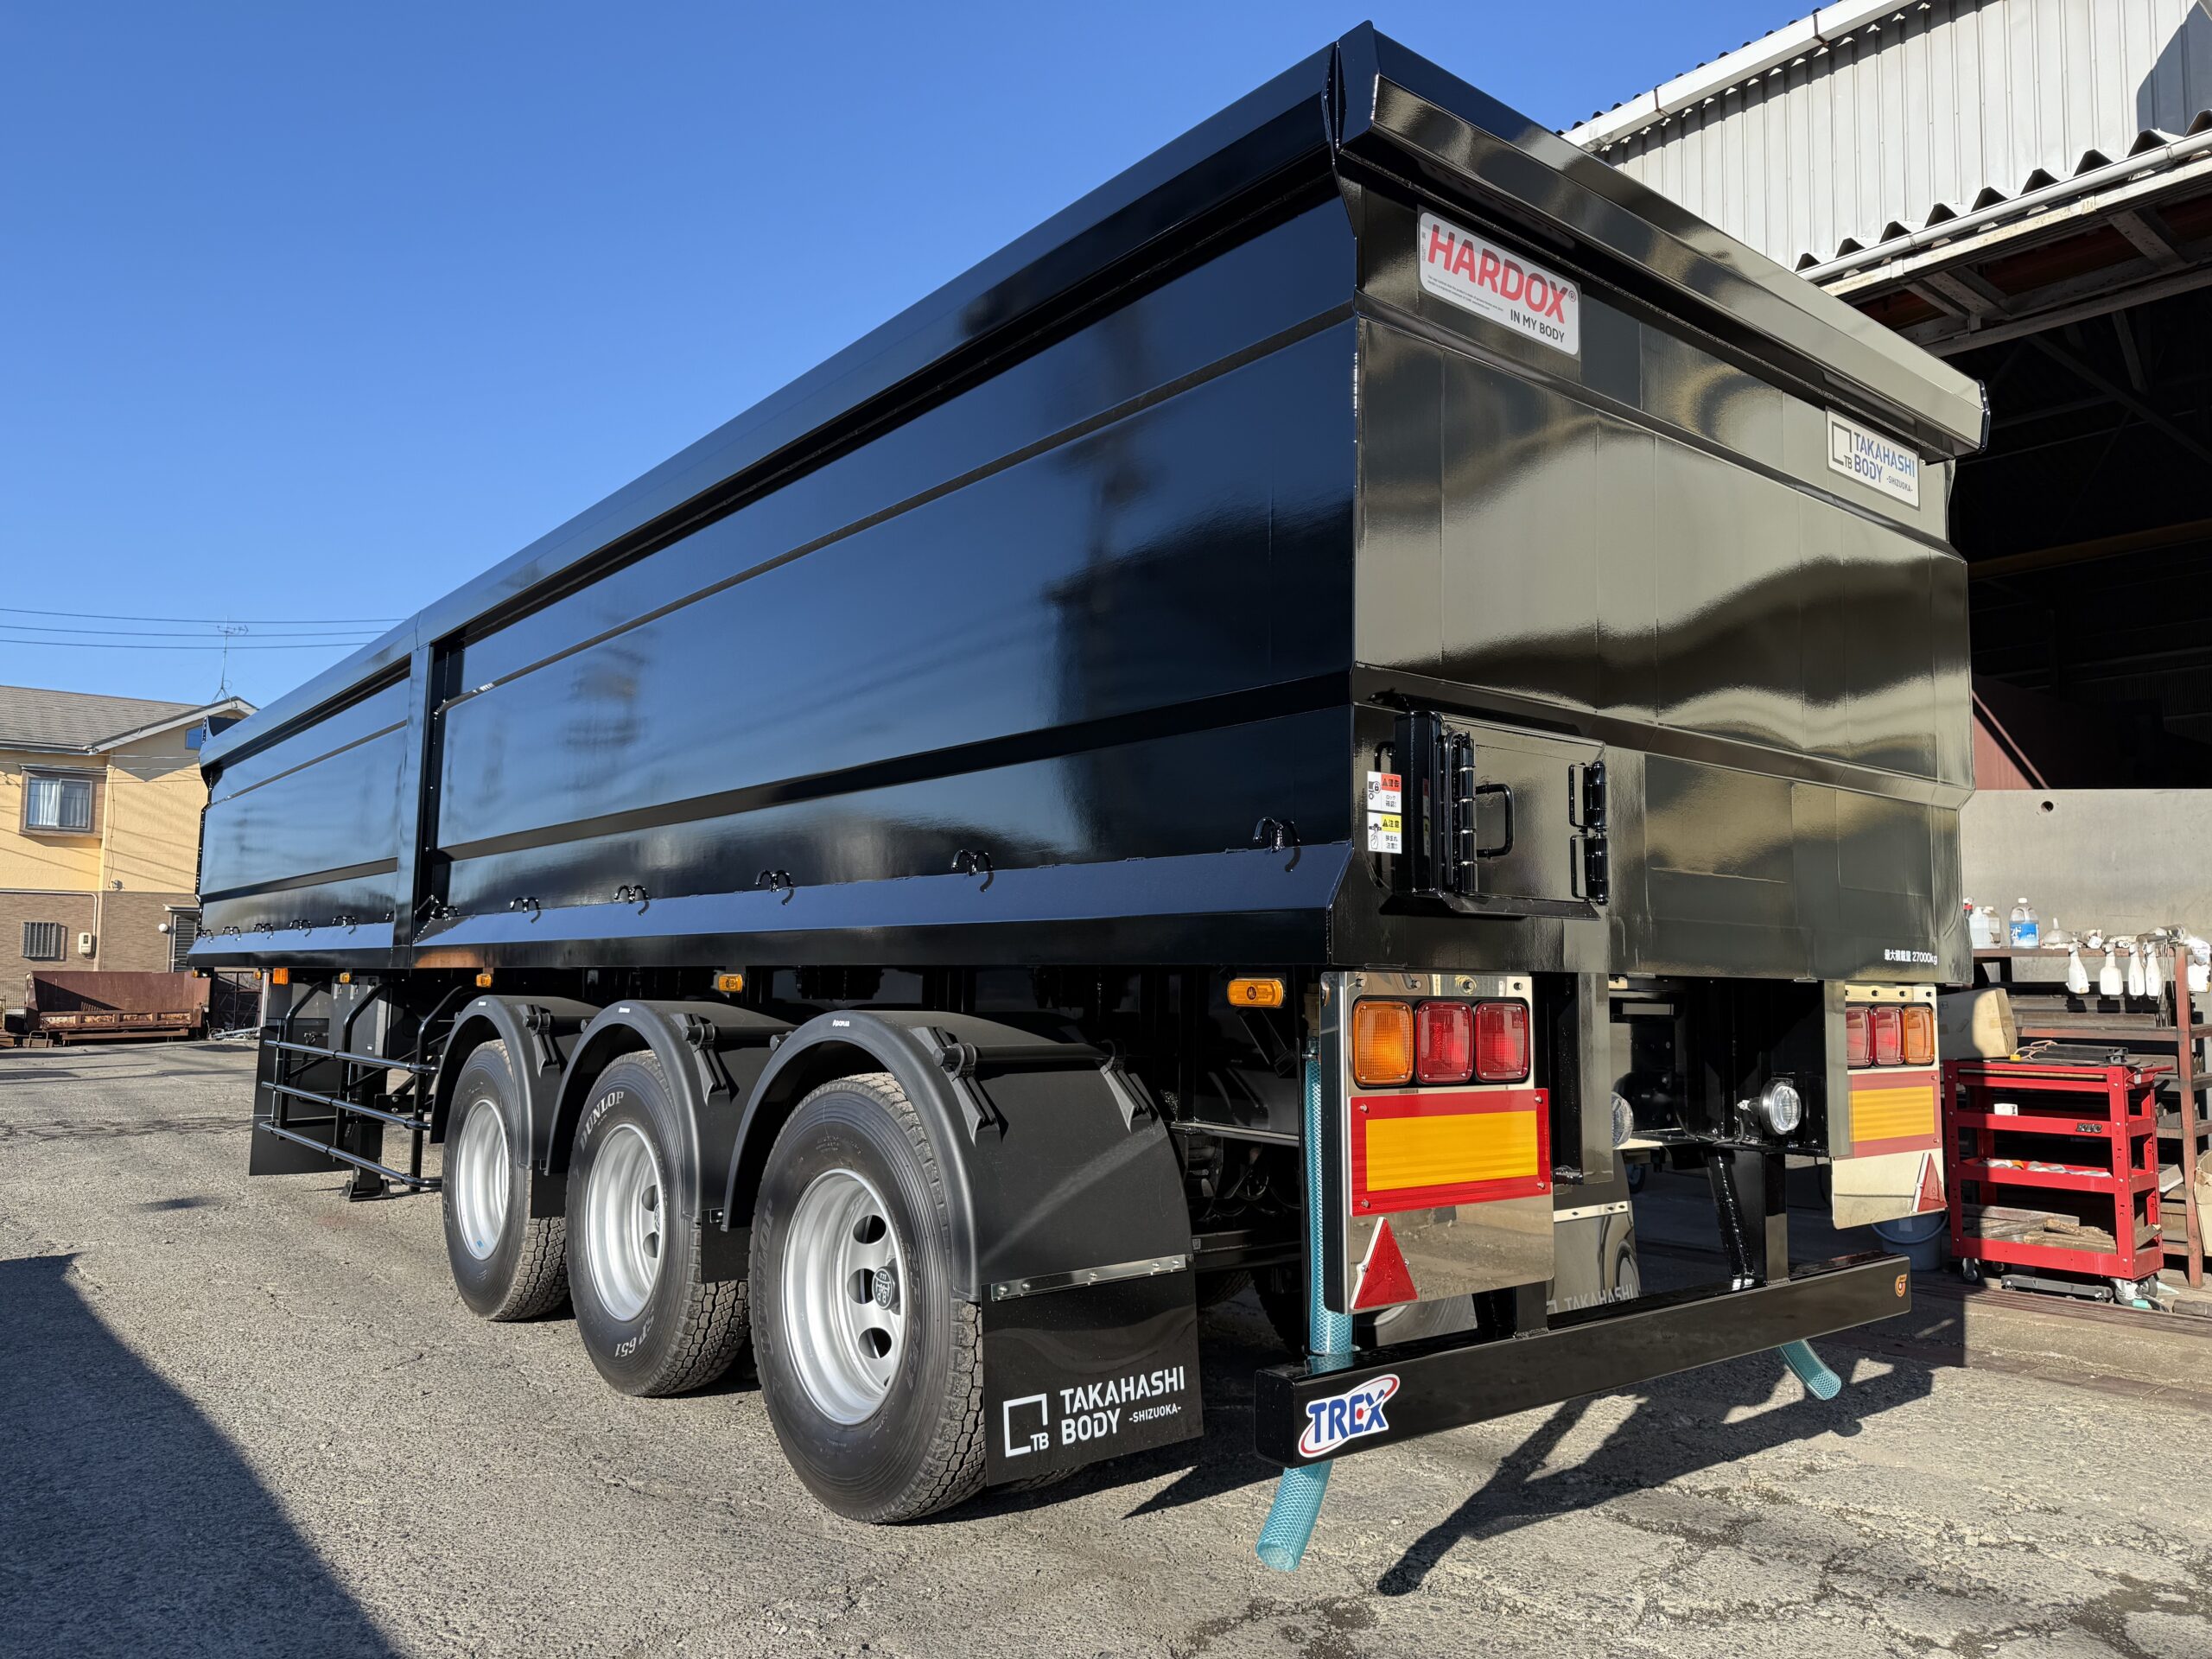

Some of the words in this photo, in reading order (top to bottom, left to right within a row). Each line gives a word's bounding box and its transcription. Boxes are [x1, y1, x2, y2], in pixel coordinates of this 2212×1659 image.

[1510, 308, 1521, 325] IN
[1522, 314, 1537, 332] MY
[1540, 323, 1565, 343] BODY
[1853, 432, 1916, 478] TAKAHASHI
[1854, 454, 1883, 483] BODY
[580, 1091, 625, 1154] DUNLOP
[614, 1337, 637, 1357] 651
[1059, 1365, 1185, 1415] TAKAHASHI
[1061, 1408, 1121, 1446] BODY
[1307, 1389, 1387, 1444] TREX
